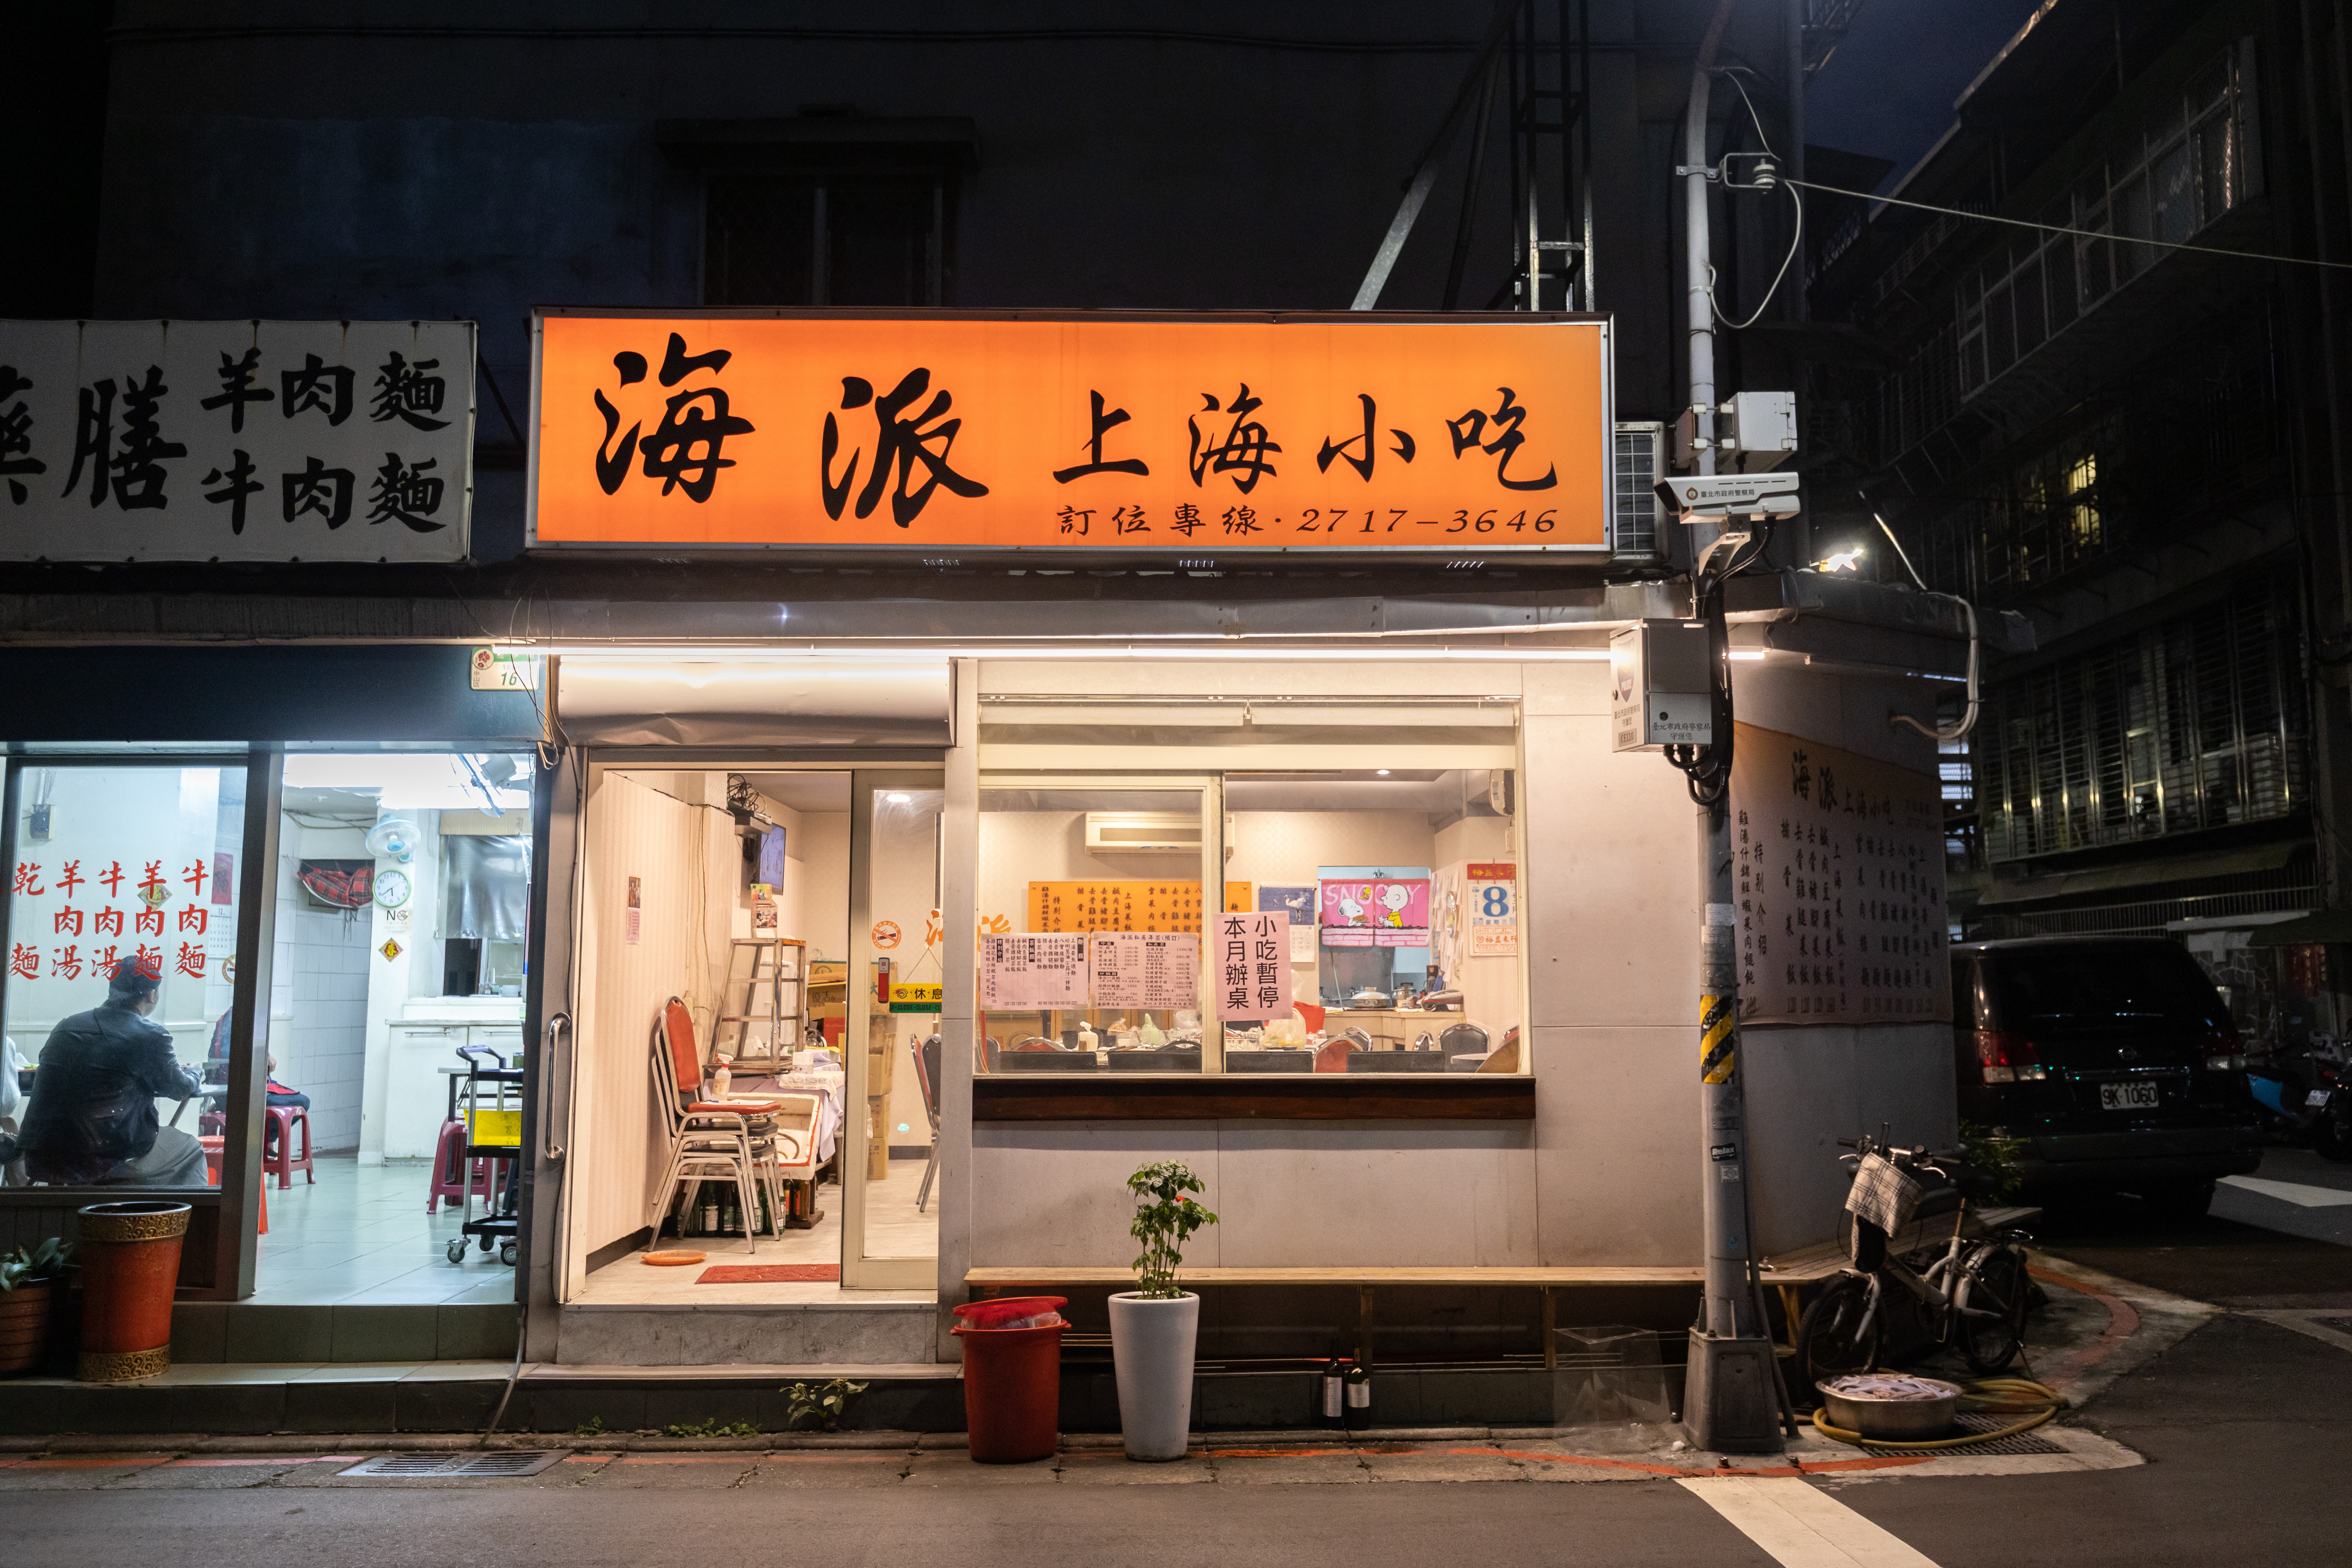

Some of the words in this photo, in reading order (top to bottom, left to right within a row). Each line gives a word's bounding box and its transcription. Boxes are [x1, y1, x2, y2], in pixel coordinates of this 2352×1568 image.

[201, 347, 452, 434] 羊肉麵
[594, 332, 989, 528] 海派
[1053, 383, 1557, 494] 上海小吃
[201, 449, 447, 535] 牛肉麵
[501, 672, 517, 685] 16
[1614, 704, 1640, 720] 臺北市政府警察局
[1621, 732, 1634, 743] CE110
[1652, 722, 1710, 731] 臺北市政府警察局
[9, 862, 44, 980] 乾麵
[51, 860, 85, 981] 羊肉湯
[91, 861, 126, 981] 牛肉湯
[132, 860, 167, 981] 羊肉麵
[174, 859, 209, 978] 牛肉麵
[1483, 886, 1509, 917] 8
[1754, 841, 1767, 956] 特別介紹
[915, 988, 942, 999] 休息
[1225, 917, 1249, 1009] 本月辦桌
[1255, 916, 1278, 1008] 小吃暫停
[2103, 1087, 2157, 1105] 9K-1060
